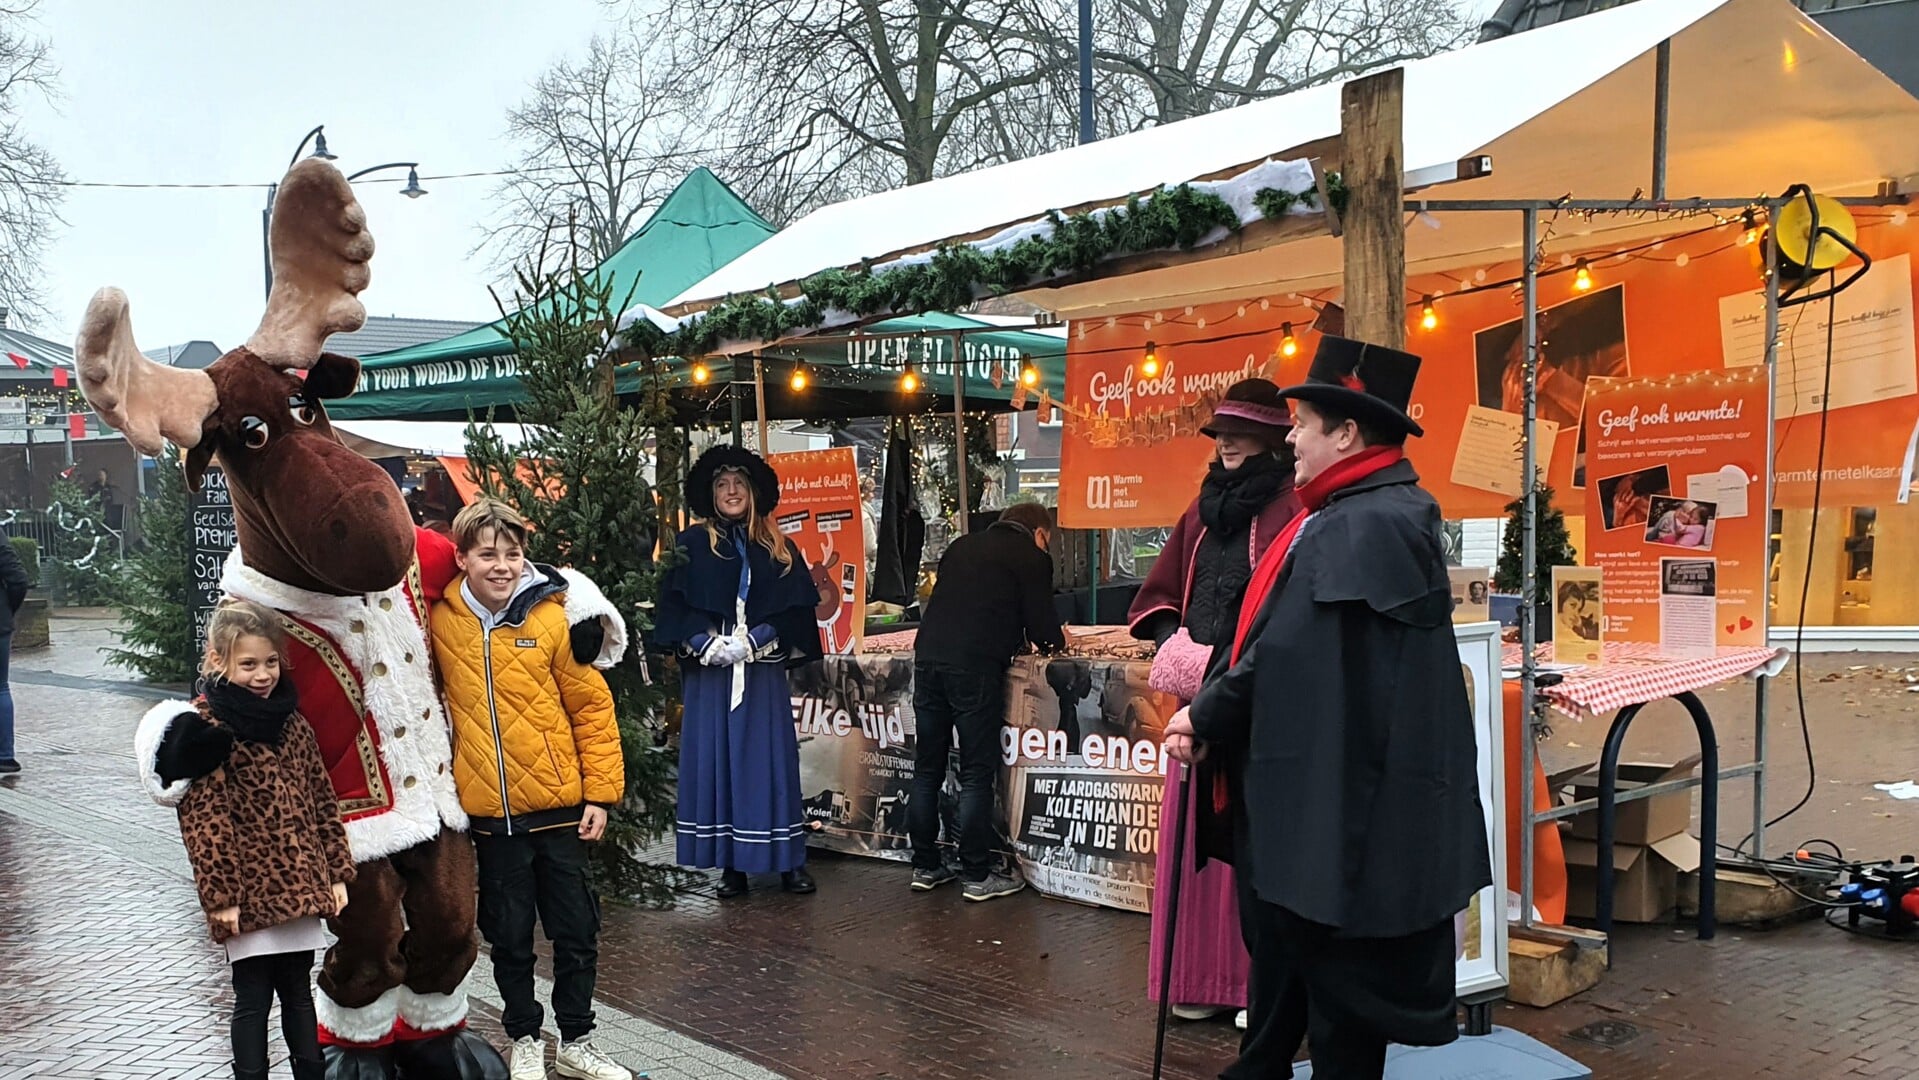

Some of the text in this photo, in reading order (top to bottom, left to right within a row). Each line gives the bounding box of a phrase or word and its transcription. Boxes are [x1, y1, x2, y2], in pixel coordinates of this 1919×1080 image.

[847, 338, 909, 372] OPEN
[372, 367, 410, 392] YOUR
[412, 359, 466, 388] WORLD
[469, 358, 490, 382] OF
[1089, 364, 1134, 416] Geef
[1136, 360, 1176, 398] ook
[1598, 399, 1744, 437] Geef ook warmte!
[1113, 474, 1143, 485] Warmte
[1113, 487, 1128, 496] met
[1113, 499, 1138, 509] elkaar
[790, 696, 905, 749] Elke tijd
[1034, 779, 1058, 794] MET
[807, 806, 832, 818] Kolen
[1069, 820, 1087, 845] IN
[1093, 824, 1117, 849] DE
